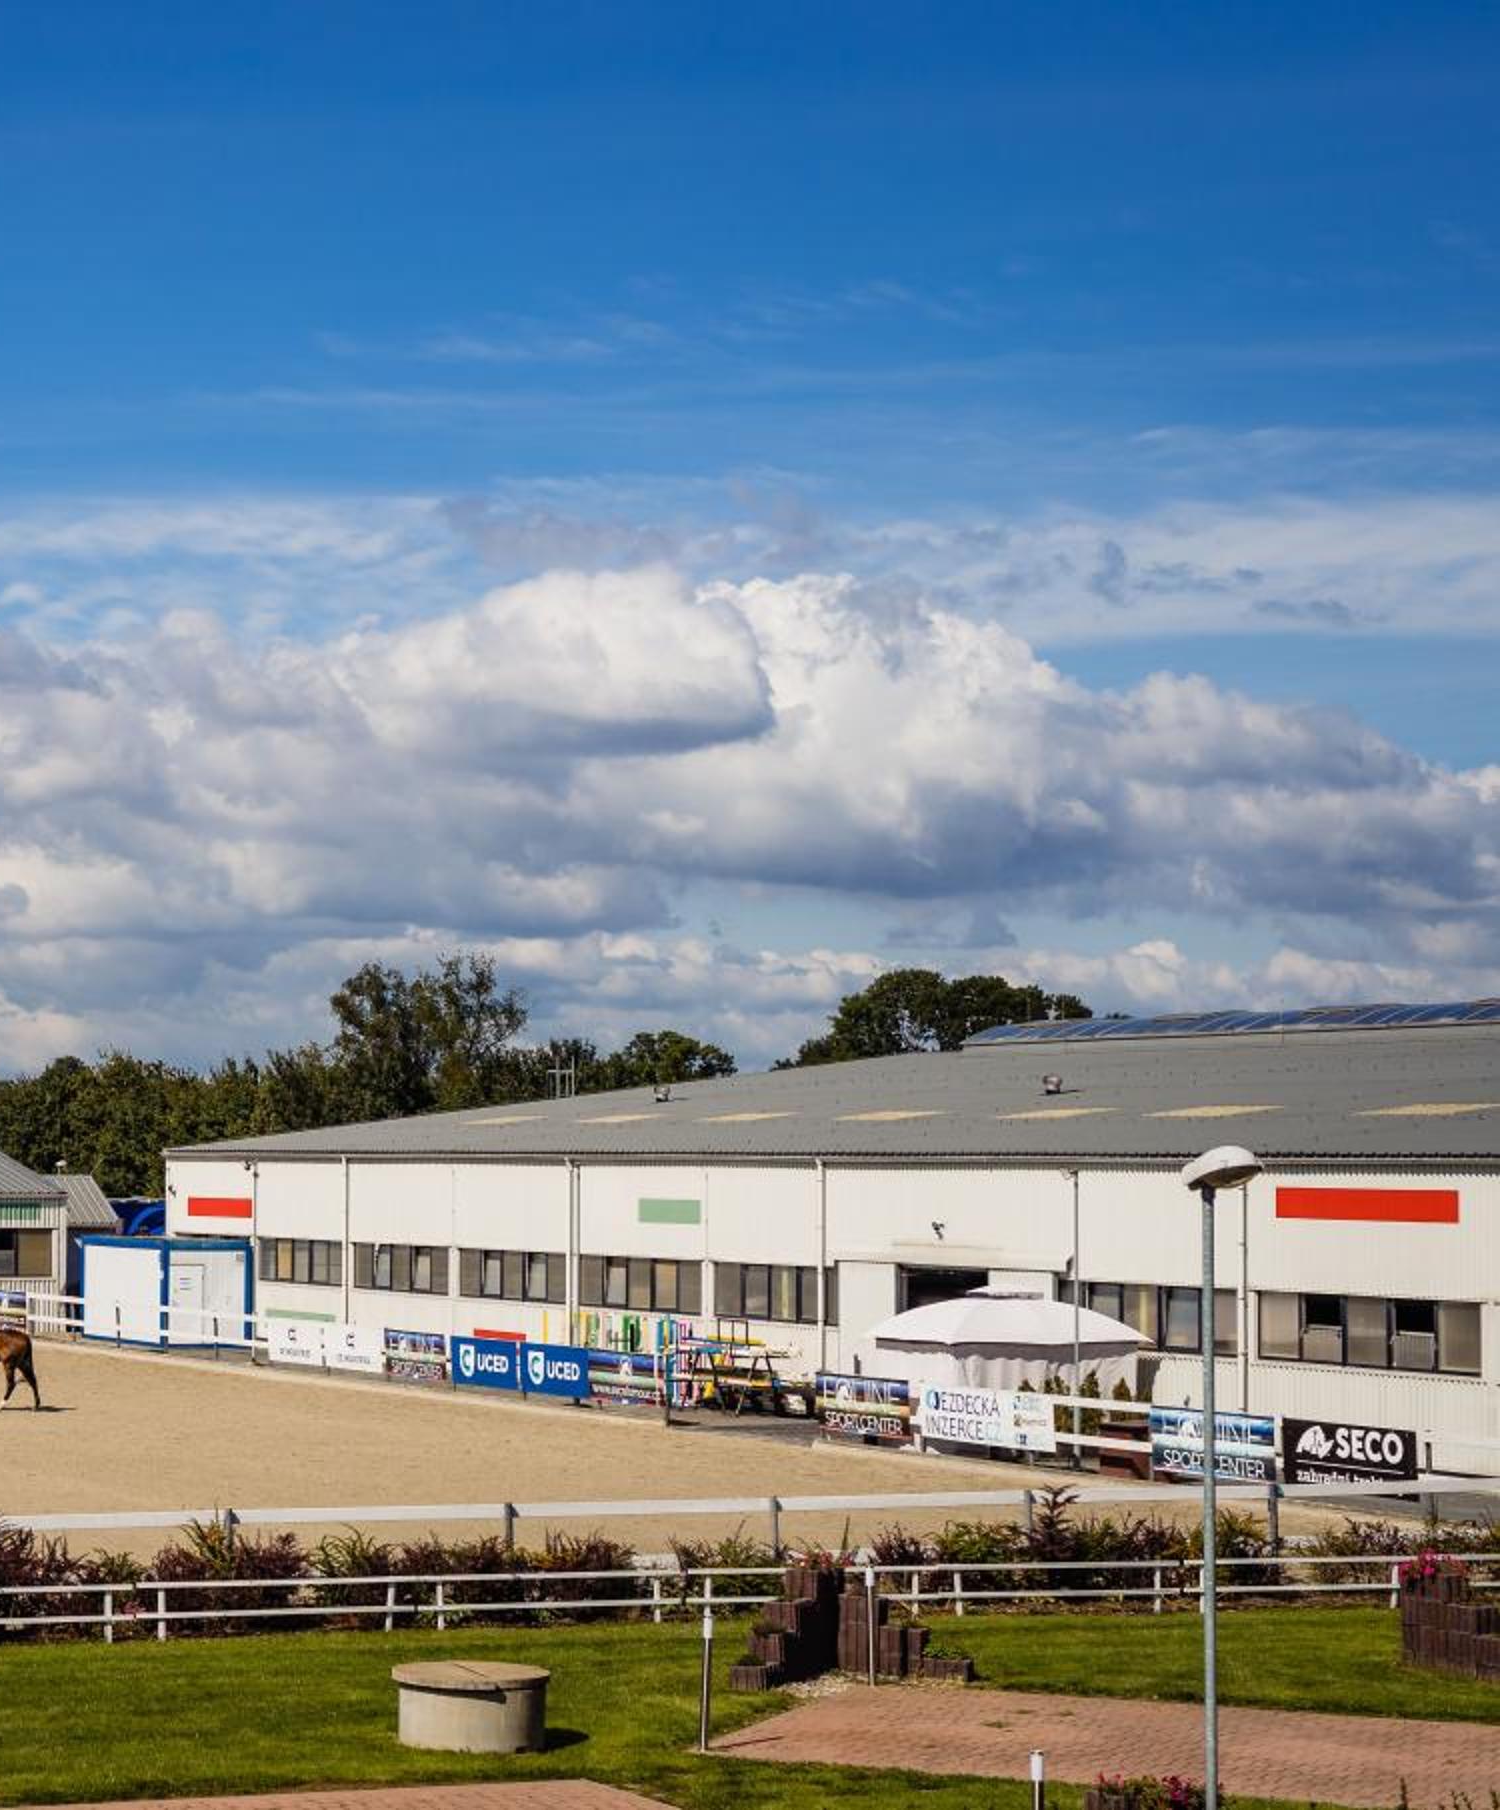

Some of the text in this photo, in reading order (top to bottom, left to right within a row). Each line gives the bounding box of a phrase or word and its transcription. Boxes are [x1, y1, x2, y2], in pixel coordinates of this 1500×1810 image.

[477, 1353, 509, 1374] UCED
[546, 1360, 580, 1381] UCED
[1335, 1427, 1404, 1465] SECO
